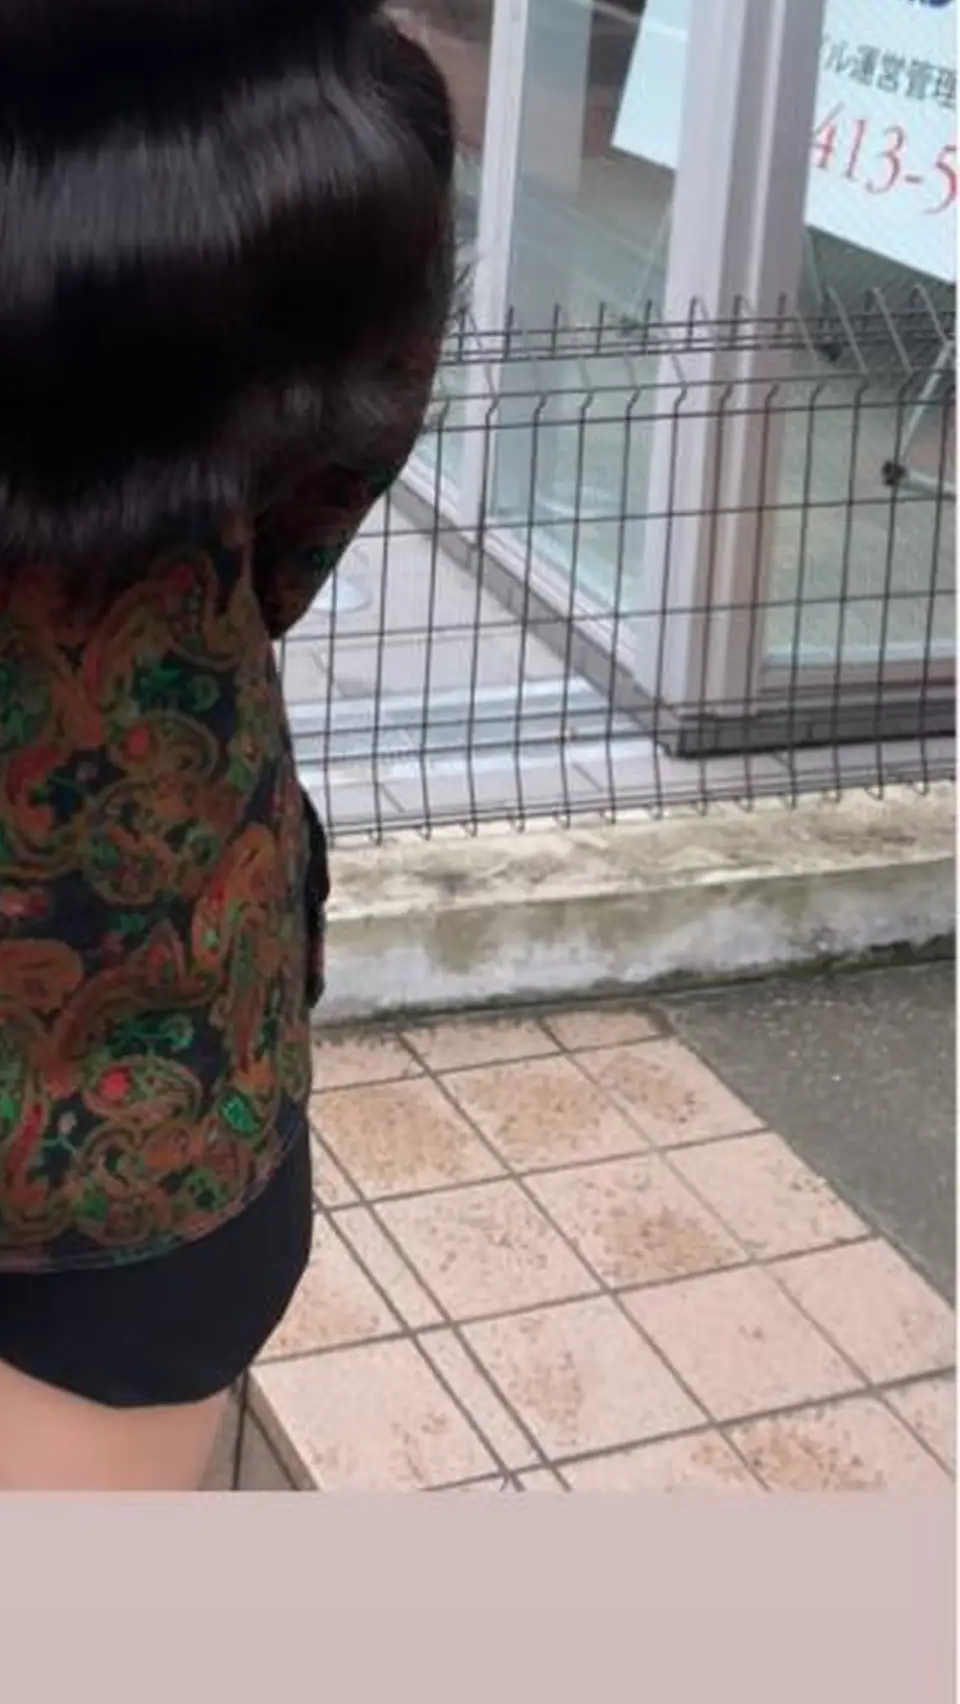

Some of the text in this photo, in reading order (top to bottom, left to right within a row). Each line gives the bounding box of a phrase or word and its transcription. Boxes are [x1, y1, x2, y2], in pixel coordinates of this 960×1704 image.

[822, 34, 956, 110] ル運営管理
